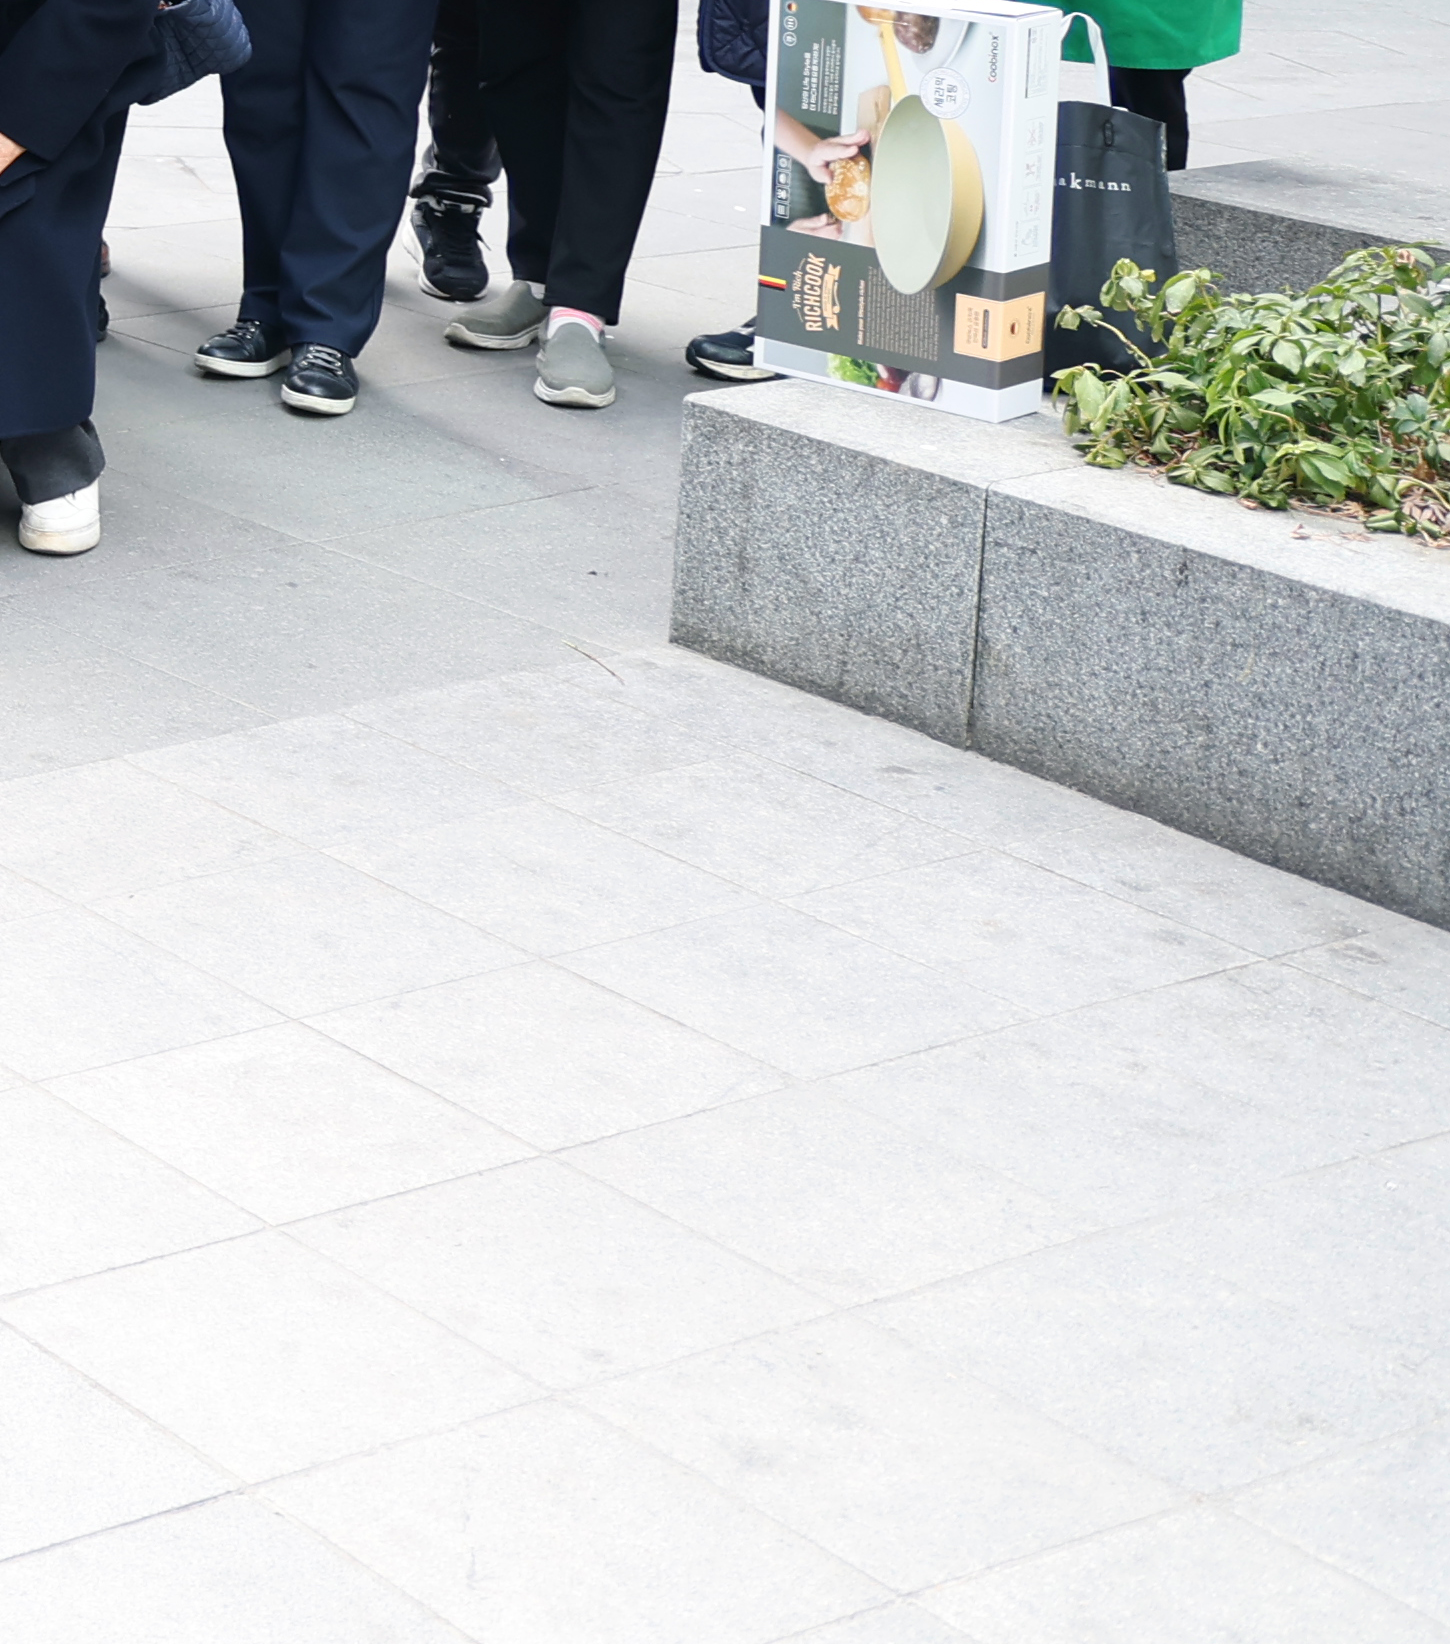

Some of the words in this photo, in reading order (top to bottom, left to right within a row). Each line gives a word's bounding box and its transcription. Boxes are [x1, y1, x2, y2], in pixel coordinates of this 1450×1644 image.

[987, 35, 1000, 83] Coobinox
[934, 76, 946, 108] 세라믹
[803, 252, 826, 332] RICHCOOK
